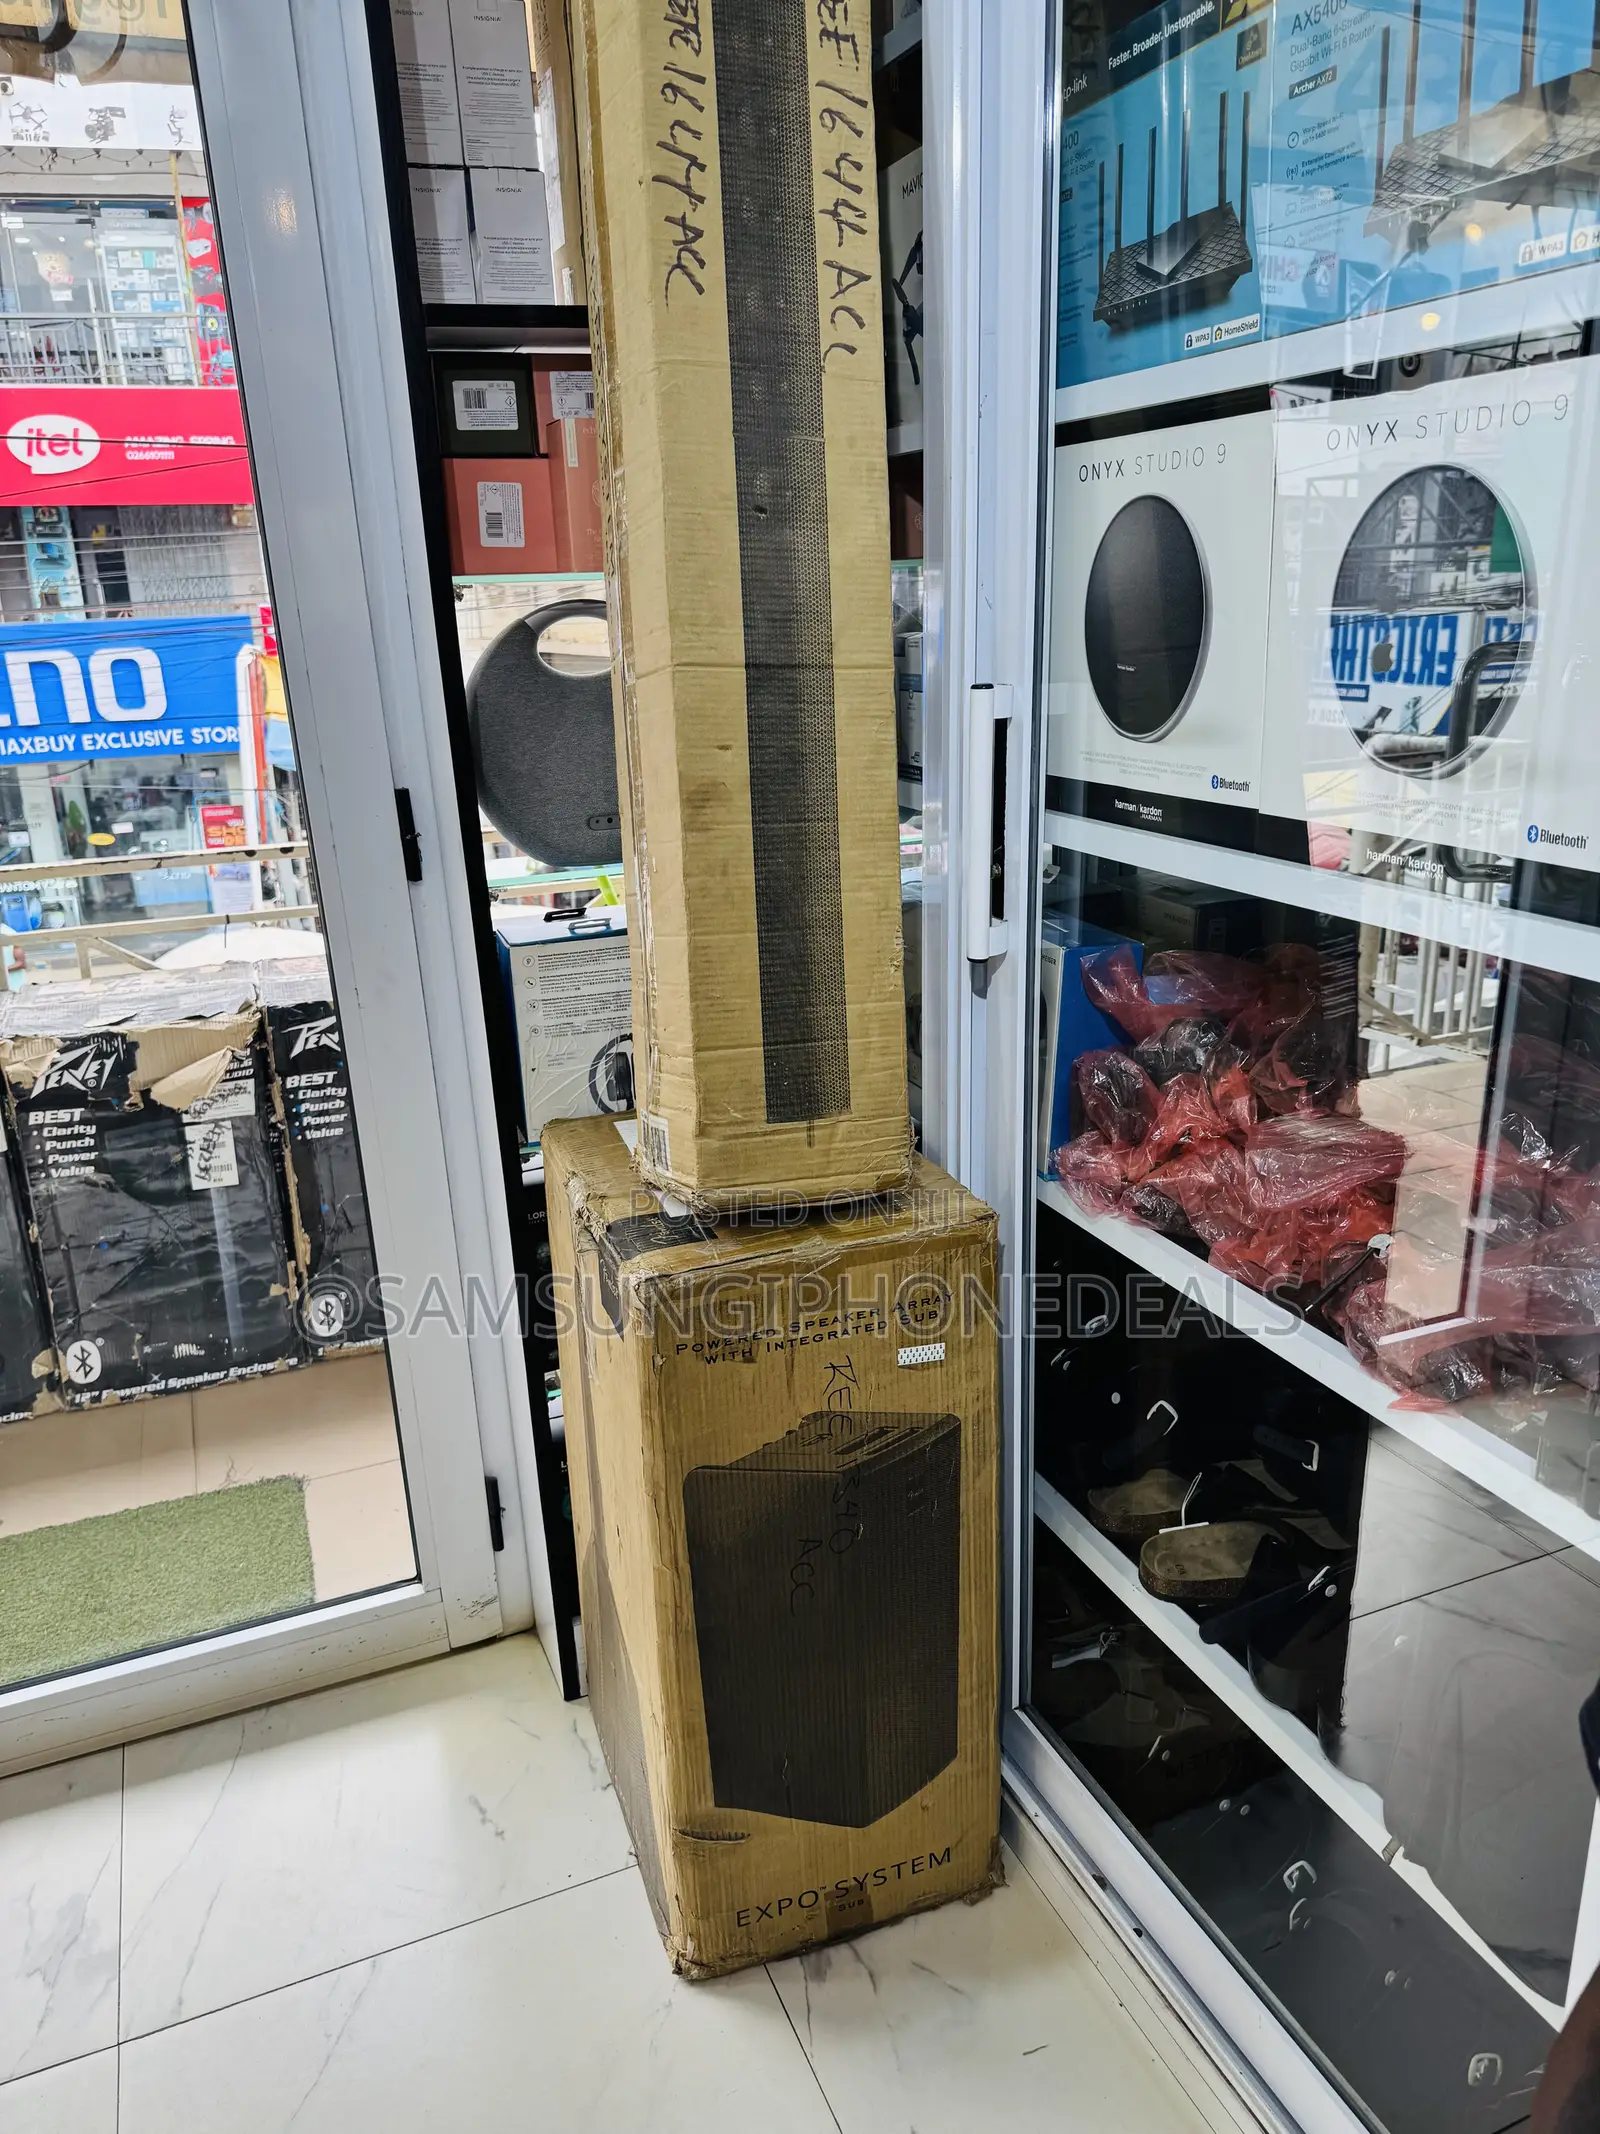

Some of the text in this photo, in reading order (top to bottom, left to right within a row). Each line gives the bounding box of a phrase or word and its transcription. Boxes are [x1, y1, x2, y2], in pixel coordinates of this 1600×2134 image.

[1108, 1, 1215, 70] Faster. Broader. Unstoppable.
[1290, 29, 1332, 56] Dual-Band
[1290, 50, 1320, 72] Gigabit
[1348, 24, 1375, 46] Router
[1293, 70, 1332, 95] Archer AX72
[816, 79, 868, 247] 1644
[1194, 333, 1209, 343] WPA3
[1224, 319, 1258, 337] HomeShield
[1327, 394, 1569, 450] ONYX STUDIO 9
[26, 428, 84, 457] itel
[1079, 443, 1226, 483] ONYX STUDIO 9
[82, 728, 185, 751] EXCLUSIVE
[191, 726, 241, 745] STOR
[1219, 777, 1251, 792] Bluetooth
[1540, 828, 1589, 850] Bluetooth
[285, 1071, 338, 1089] BEST
[297, 1086, 347, 1100] Clarity
[28, 1107, 86, 1125] BEST
[300, 1099, 345, 1113] Punch
[302, 1113, 347, 1126] Power
[42, 1124, 97, 1138] Clarity
[304, 1127, 343, 1140] Value
[44, 1136, 95, 1151] Punch
[47, 1151, 99, 1165] Power
[50, 1165, 95, 1179] Value
[675, 1292, 955, 1355] POWERED SPEAKER ARRAY
[704, 1309, 939, 1365] WITH INTEGRATED SUB
[166, 1368, 228, 1390] Speaker
[834, 1846, 951, 1899] SYSTEM
[838, 1898, 865, 1912] SUB
